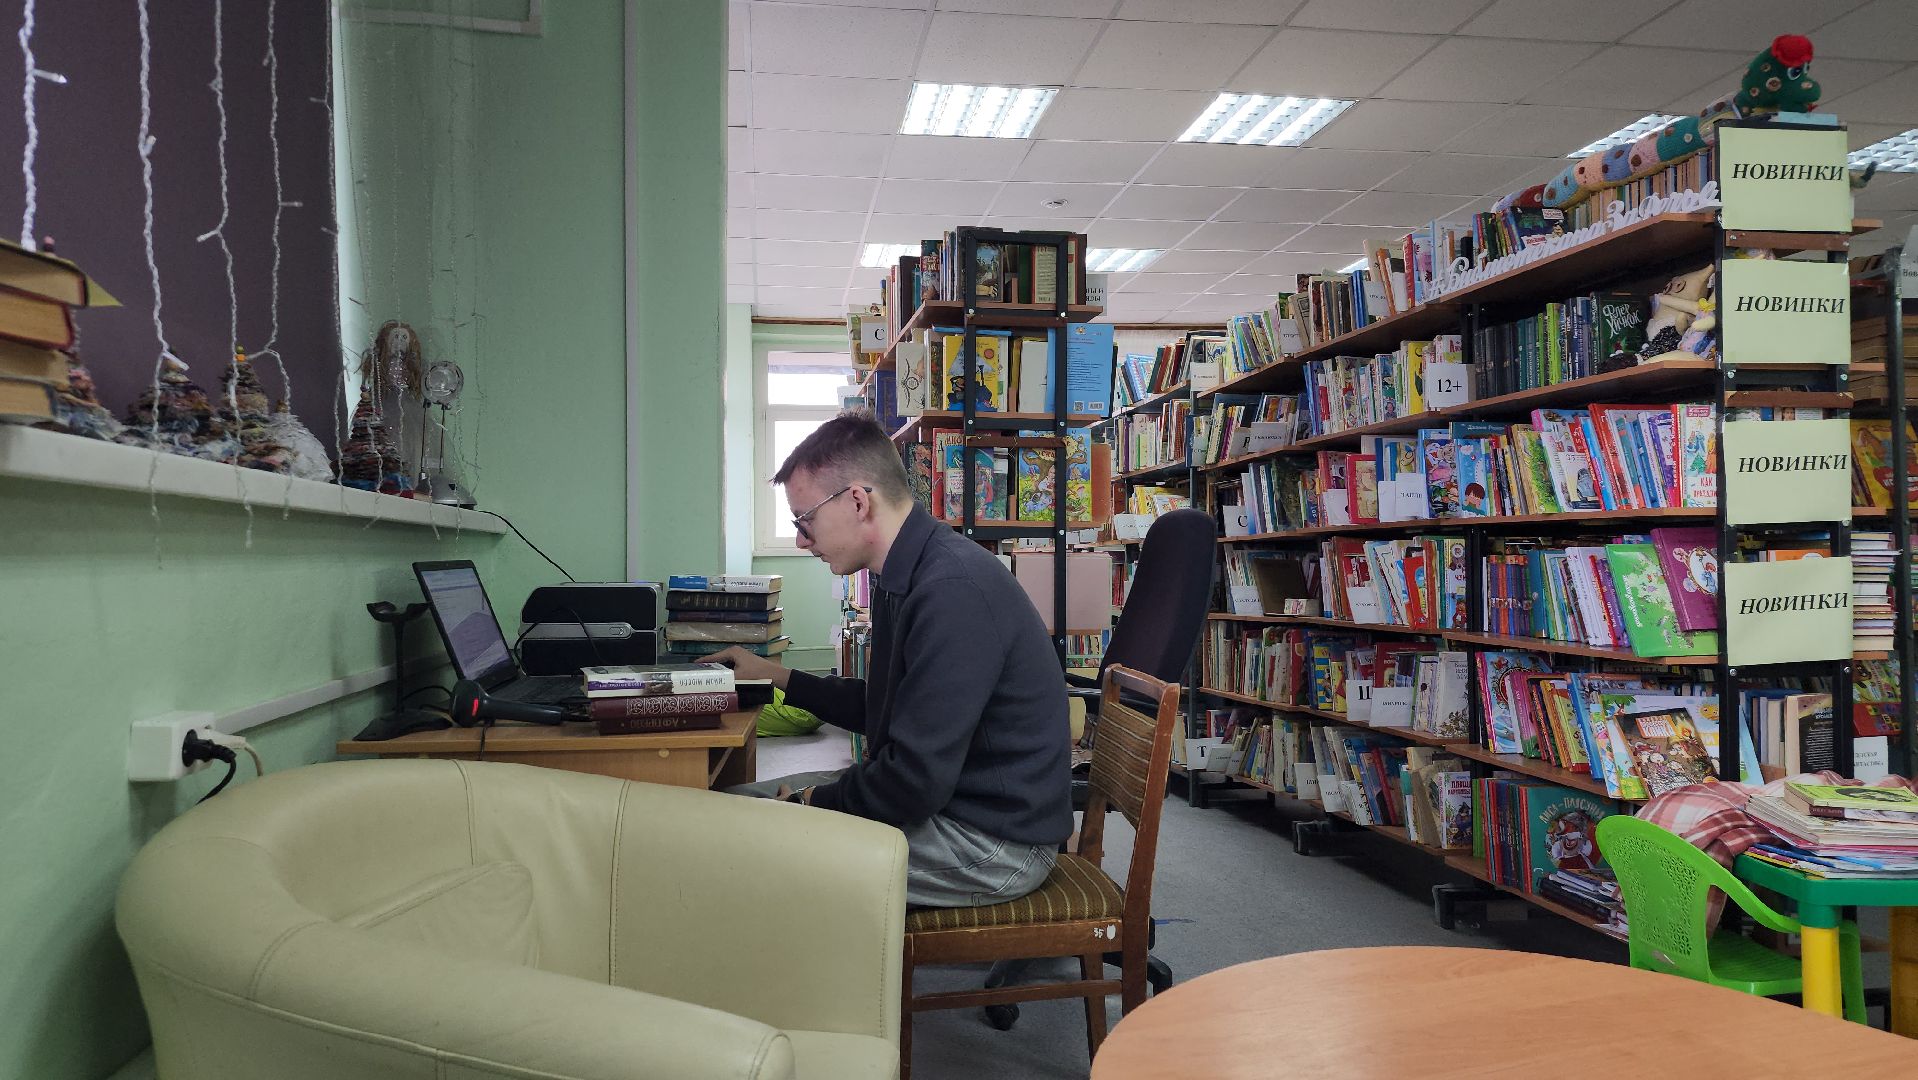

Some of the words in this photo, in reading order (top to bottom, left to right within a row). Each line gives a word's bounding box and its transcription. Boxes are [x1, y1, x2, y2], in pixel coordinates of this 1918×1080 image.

[1732, 163, 1845, 181] НОВИНКИ
[1736, 295, 1846, 314] НОВИНКИ
[1437, 378, 1463, 393] 12+
[1739, 454, 1848, 473] НОВИНКИ
[1739, 592, 1848, 615] НОВИНКИ
